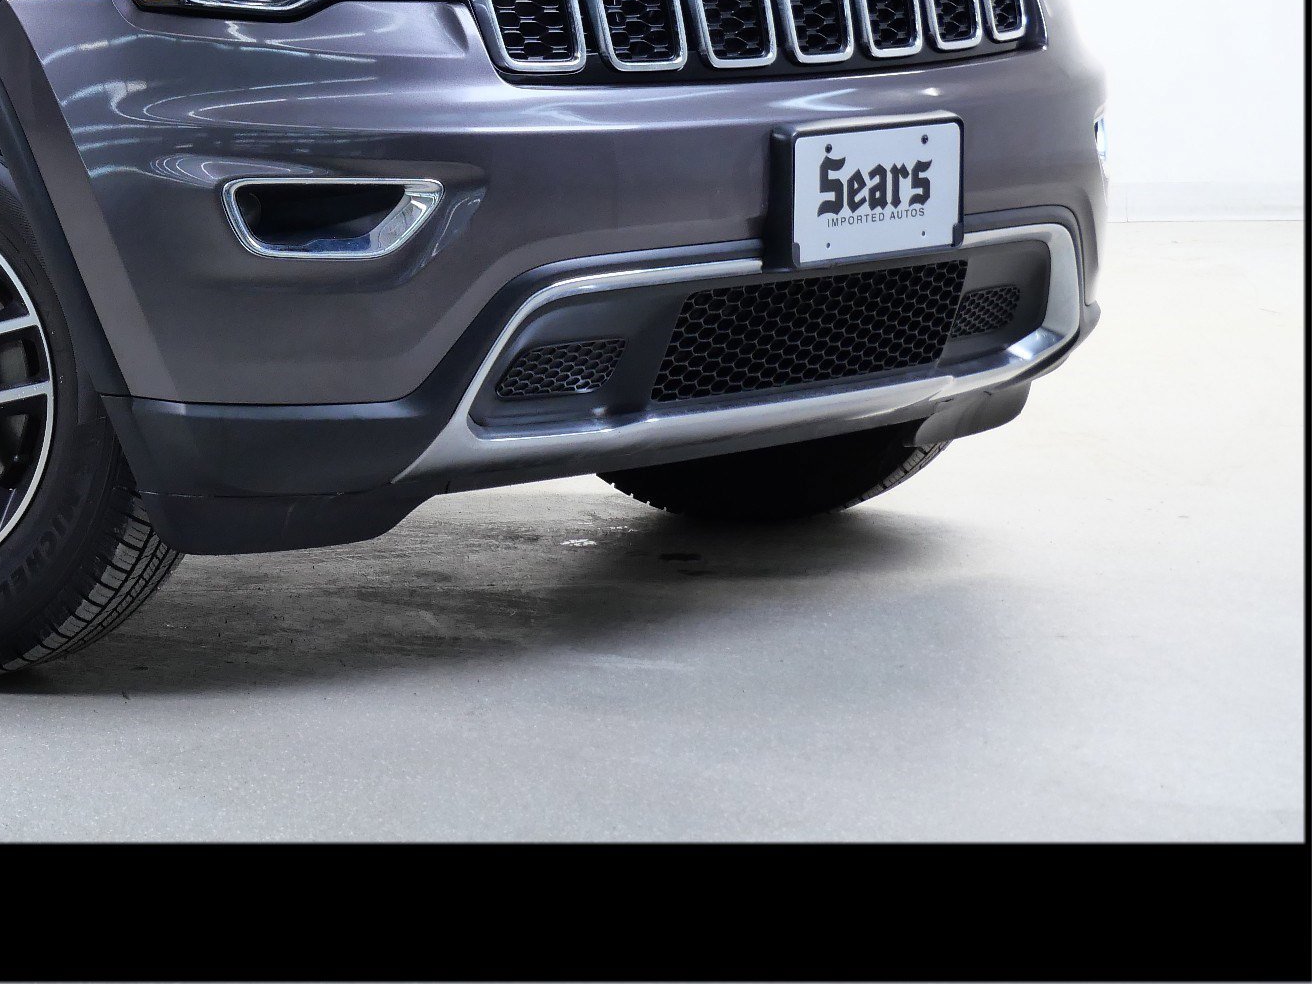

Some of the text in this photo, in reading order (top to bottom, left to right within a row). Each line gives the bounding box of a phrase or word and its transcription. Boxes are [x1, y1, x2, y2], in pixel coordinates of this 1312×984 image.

[817, 155, 933, 217] Sears
[827, 207, 925, 228] IMPORTED AUTOS
